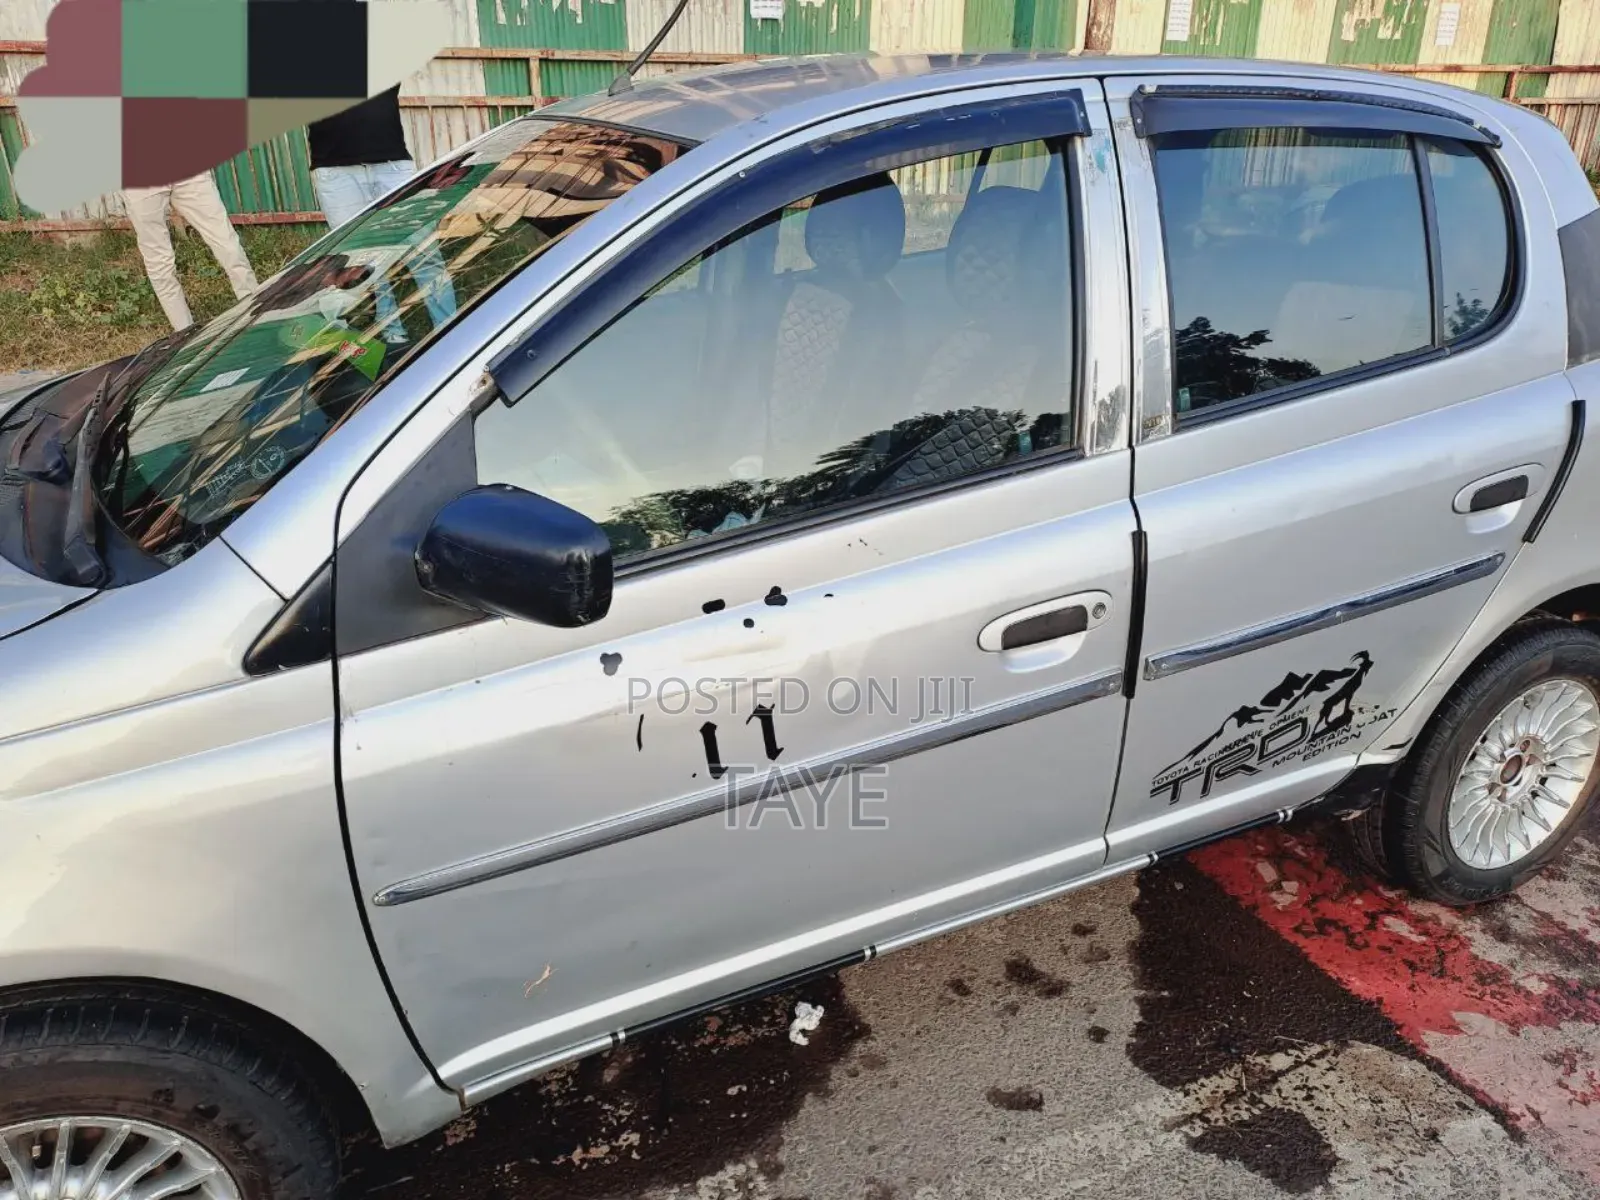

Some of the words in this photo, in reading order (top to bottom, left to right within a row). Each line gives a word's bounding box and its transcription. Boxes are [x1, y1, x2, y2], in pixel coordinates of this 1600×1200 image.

[1149, 716, 1311, 806] TRD
[1272, 724, 1352, 768] MOUNTAIN
[1302, 731, 1362, 762] EDITION
[1151, 766, 1189, 787] TOYOTA
